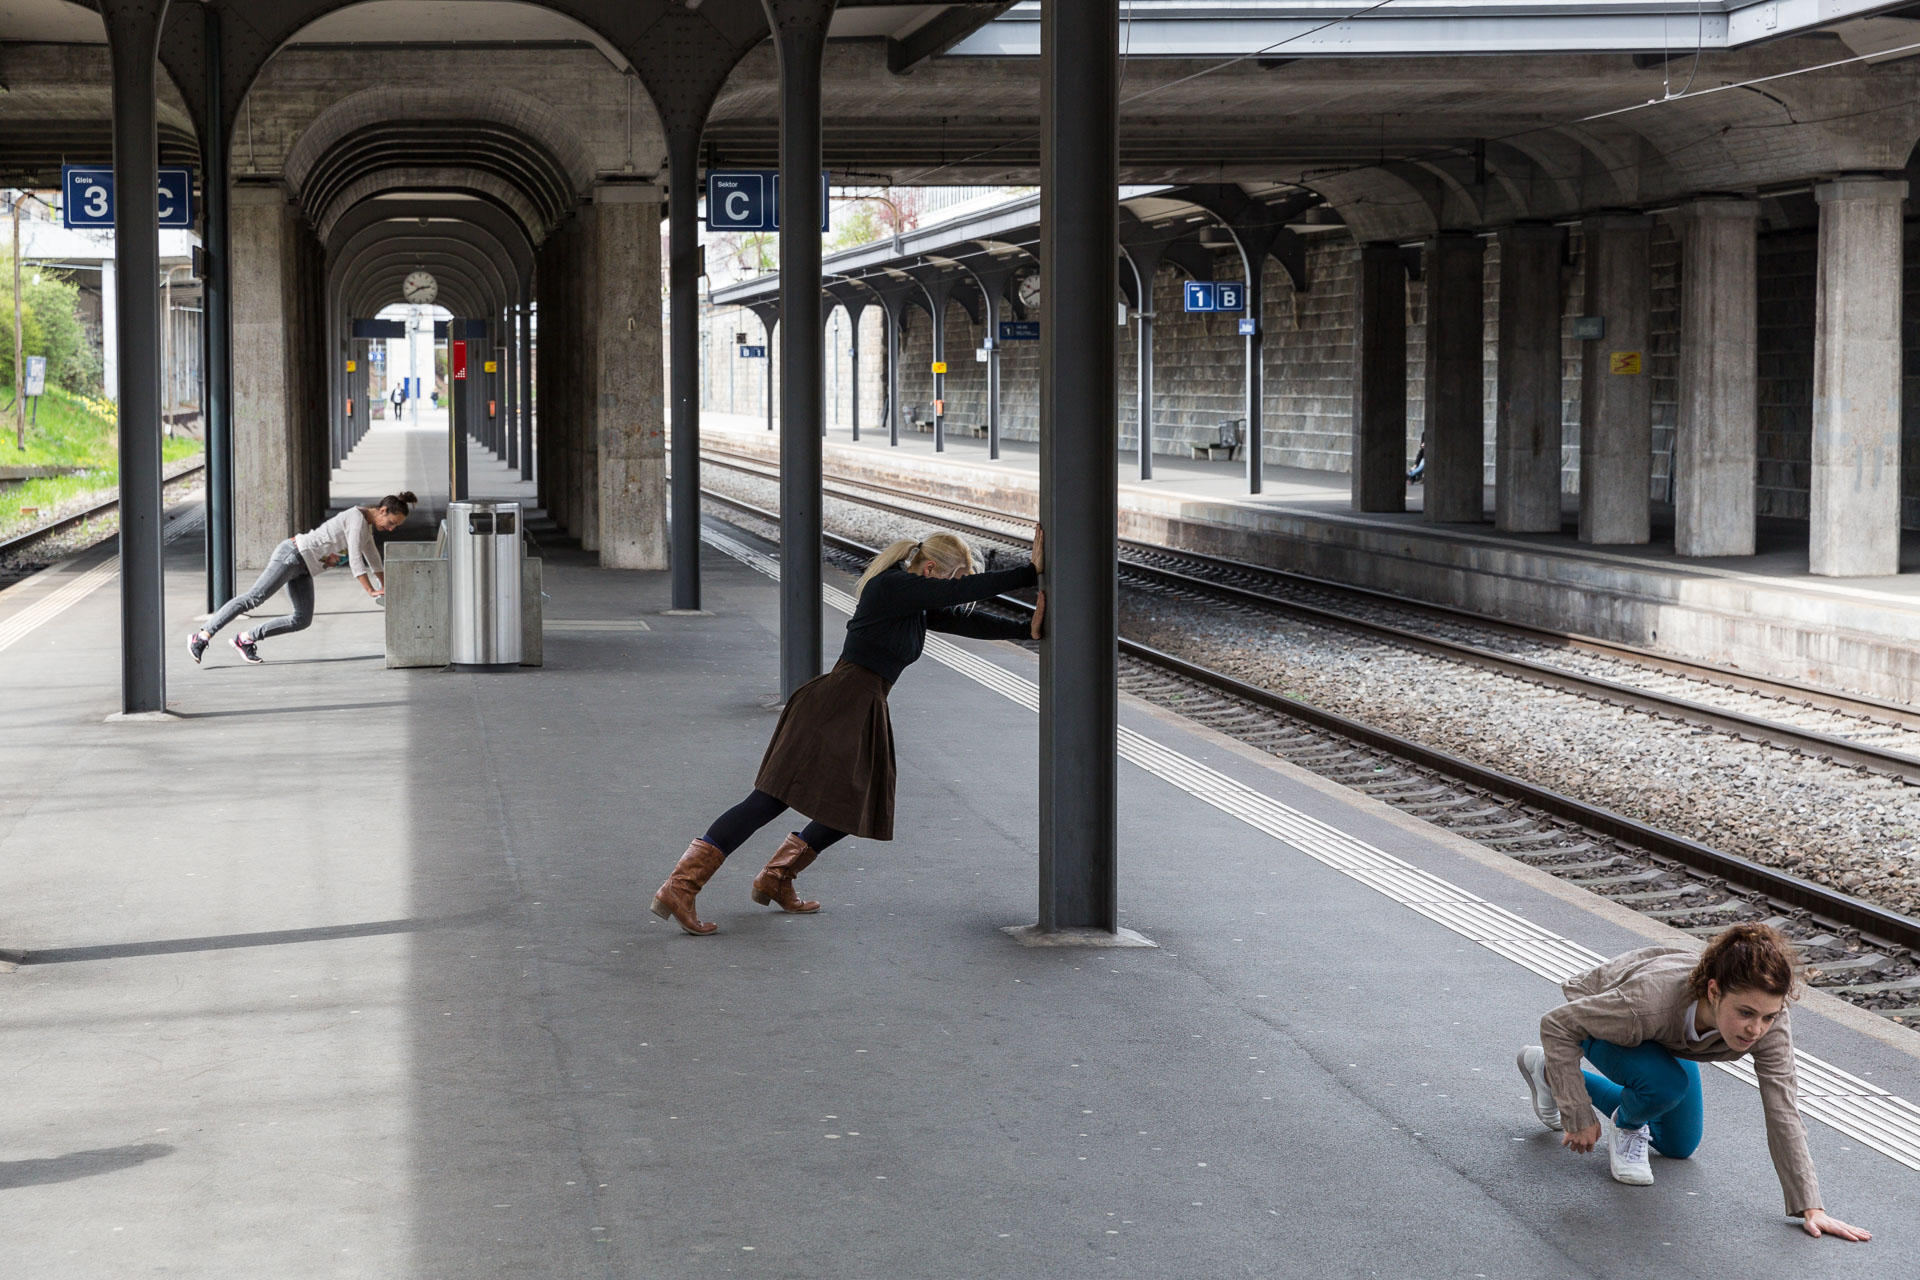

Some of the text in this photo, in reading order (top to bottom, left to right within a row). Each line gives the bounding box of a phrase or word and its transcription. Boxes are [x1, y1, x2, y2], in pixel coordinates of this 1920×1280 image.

[75, 176, 93, 184] Gleis
[84, 186, 108, 218] 3
[725, 191, 750, 221] C
[1196, 291, 1204, 307] 1
[1223, 291, 1236, 307] B
